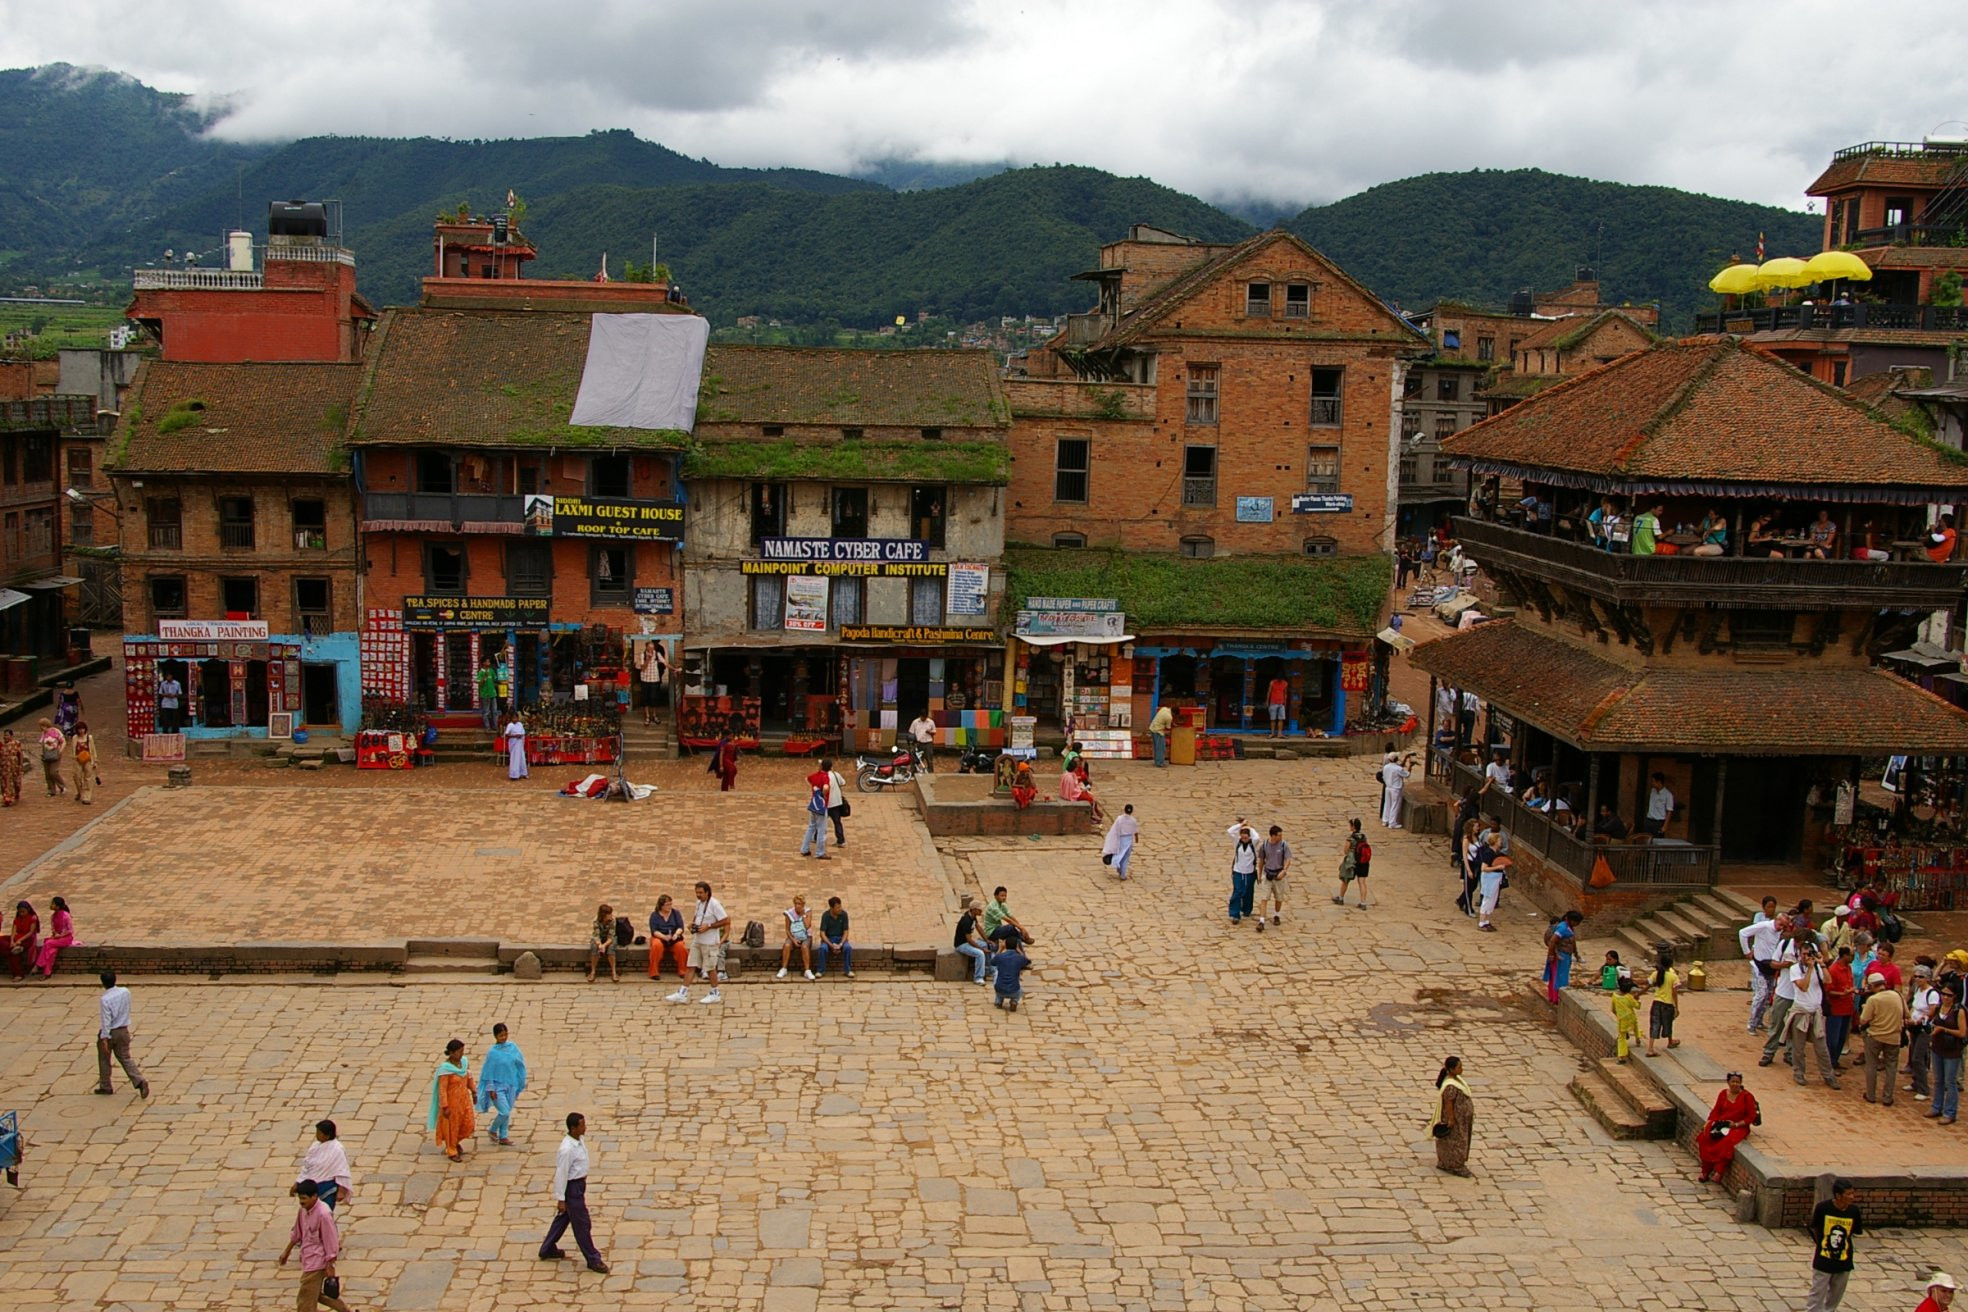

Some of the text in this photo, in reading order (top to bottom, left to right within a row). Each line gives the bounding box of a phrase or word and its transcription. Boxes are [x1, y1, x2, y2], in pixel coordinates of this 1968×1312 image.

[555, 504, 683, 521] LAXMI GUEST HOUSE
[577, 524, 660, 536] ROOF TOP CAFE
[764, 540, 923, 560] NAMASTE CYBER CAFE
[742, 562, 808, 575] MAINPOINT
[814, 562, 879, 576] COMPUTER
[885, 563, 947, 576] INSTITUTE
[461, 598, 468, 608] &
[470, 598, 516, 609] HANDMADE
[518, 599, 547, 610] PAPER
[1056, 600, 1072, 609] PAPER
[1081, 600, 1097, 610] PAPER
[1097, 600, 1116, 610] CRAFTS
[459, 610, 494, 621] CENTRE
[162, 626, 266, 638] THANGKA PAINTING
[841, 626, 994, 641] Pagoda Handicraft & Pashmina Centre
